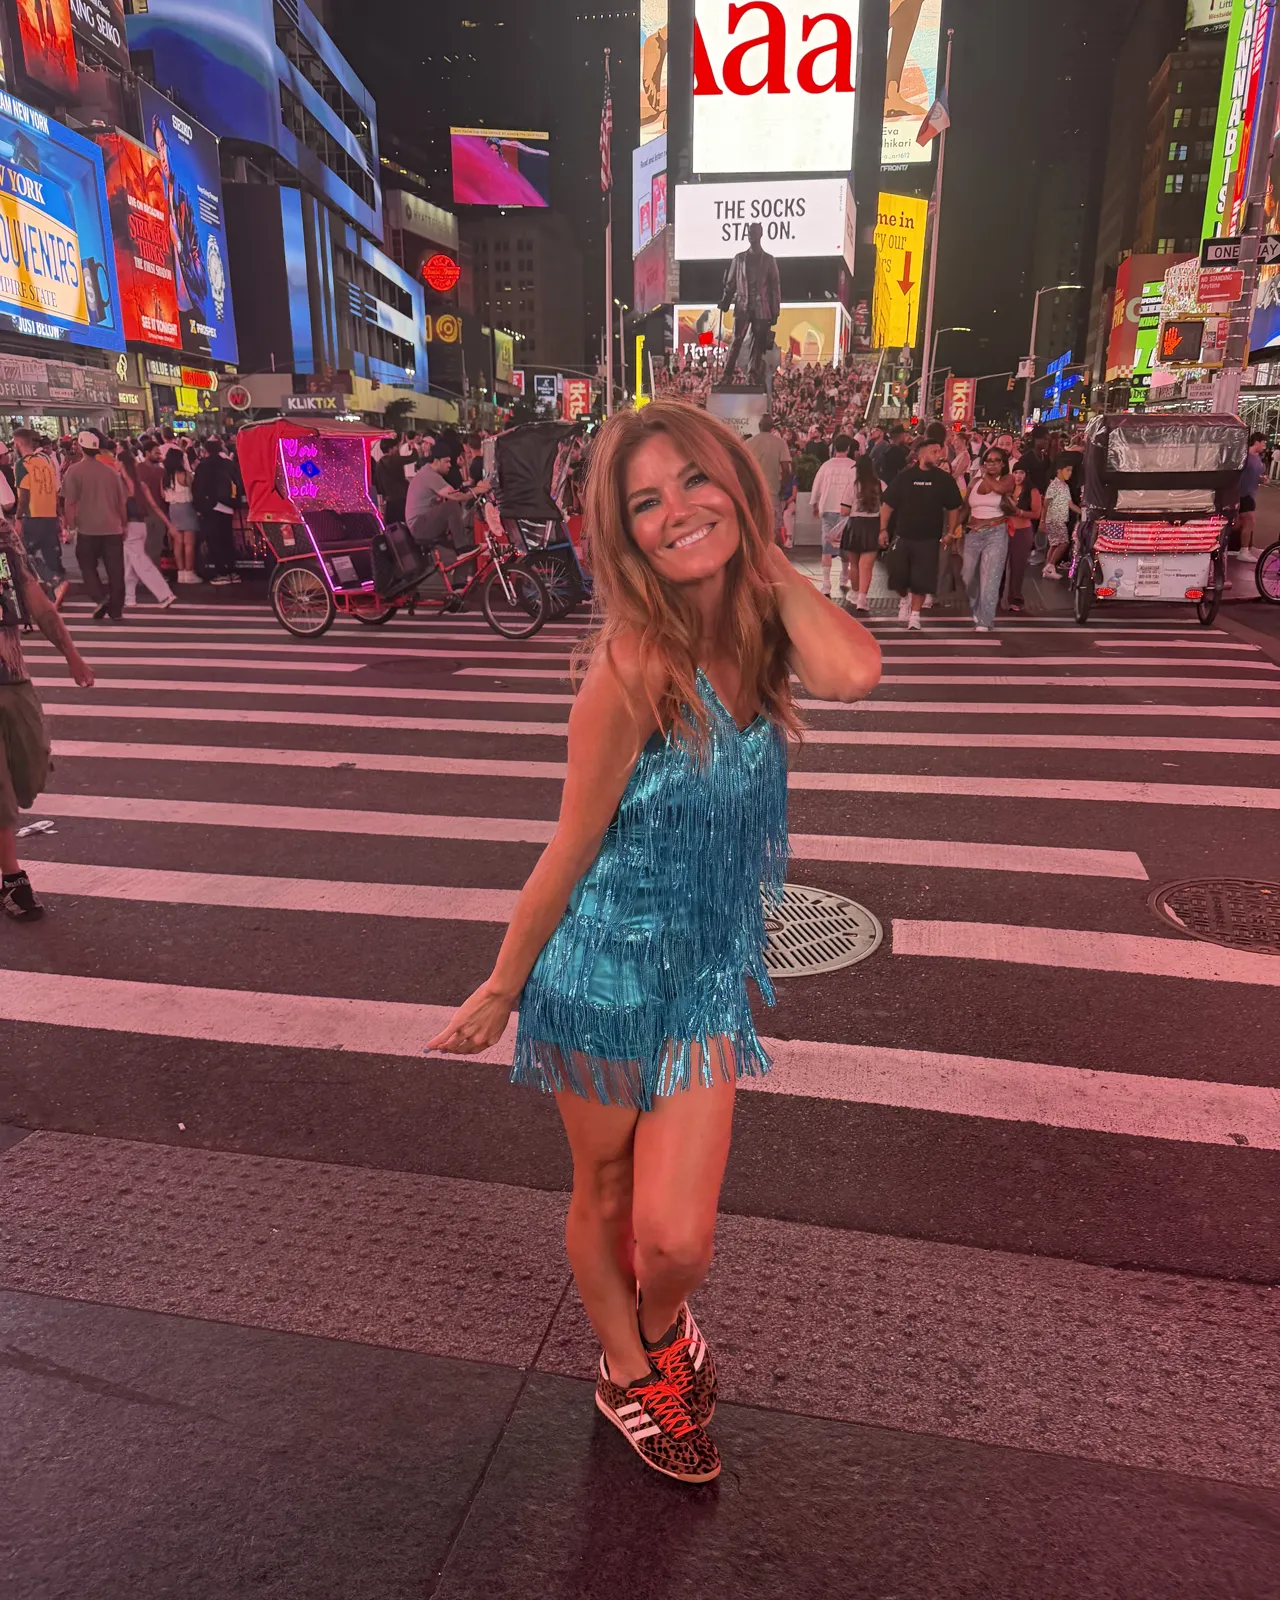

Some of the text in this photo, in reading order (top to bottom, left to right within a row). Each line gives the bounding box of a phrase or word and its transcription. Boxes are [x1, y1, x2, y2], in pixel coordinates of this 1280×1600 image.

[96, 14, 120, 48] SEIKO
[12, 99, 29, 124] NEW
[29, 107, 50, 135] YORK
[1216, 0, 1257, 214] ANNABIS
[172, 115, 193, 140] SEIKO
[882, 137, 912, 148] hikari
[7, 168, 46, 205] YORK
[714, 198, 806, 219] THE SOCKS
[899, 211, 915, 229] in
[128, 213, 171, 253] STRANGER
[721, 221, 796, 242] STA ON.
[888, 234, 907, 250] our
[137, 238, 166, 265] THINGS
[1214, 243, 1279, 259] ONE AY
[1200, 275, 1209, 283] NO
[1200, 282, 1221, 291] Anytime
[28, 283, 58, 308] STATE
[18, 316, 36, 334] JUST
[141, 315, 152, 330] SEE
[151, 360, 181, 378] BLUE FIN
[287, 396, 337, 409] KLIKTIX
[569, 381, 586, 420] tkts
[882, 382, 901, 407] R
[951, 381, 972, 420] tkts
